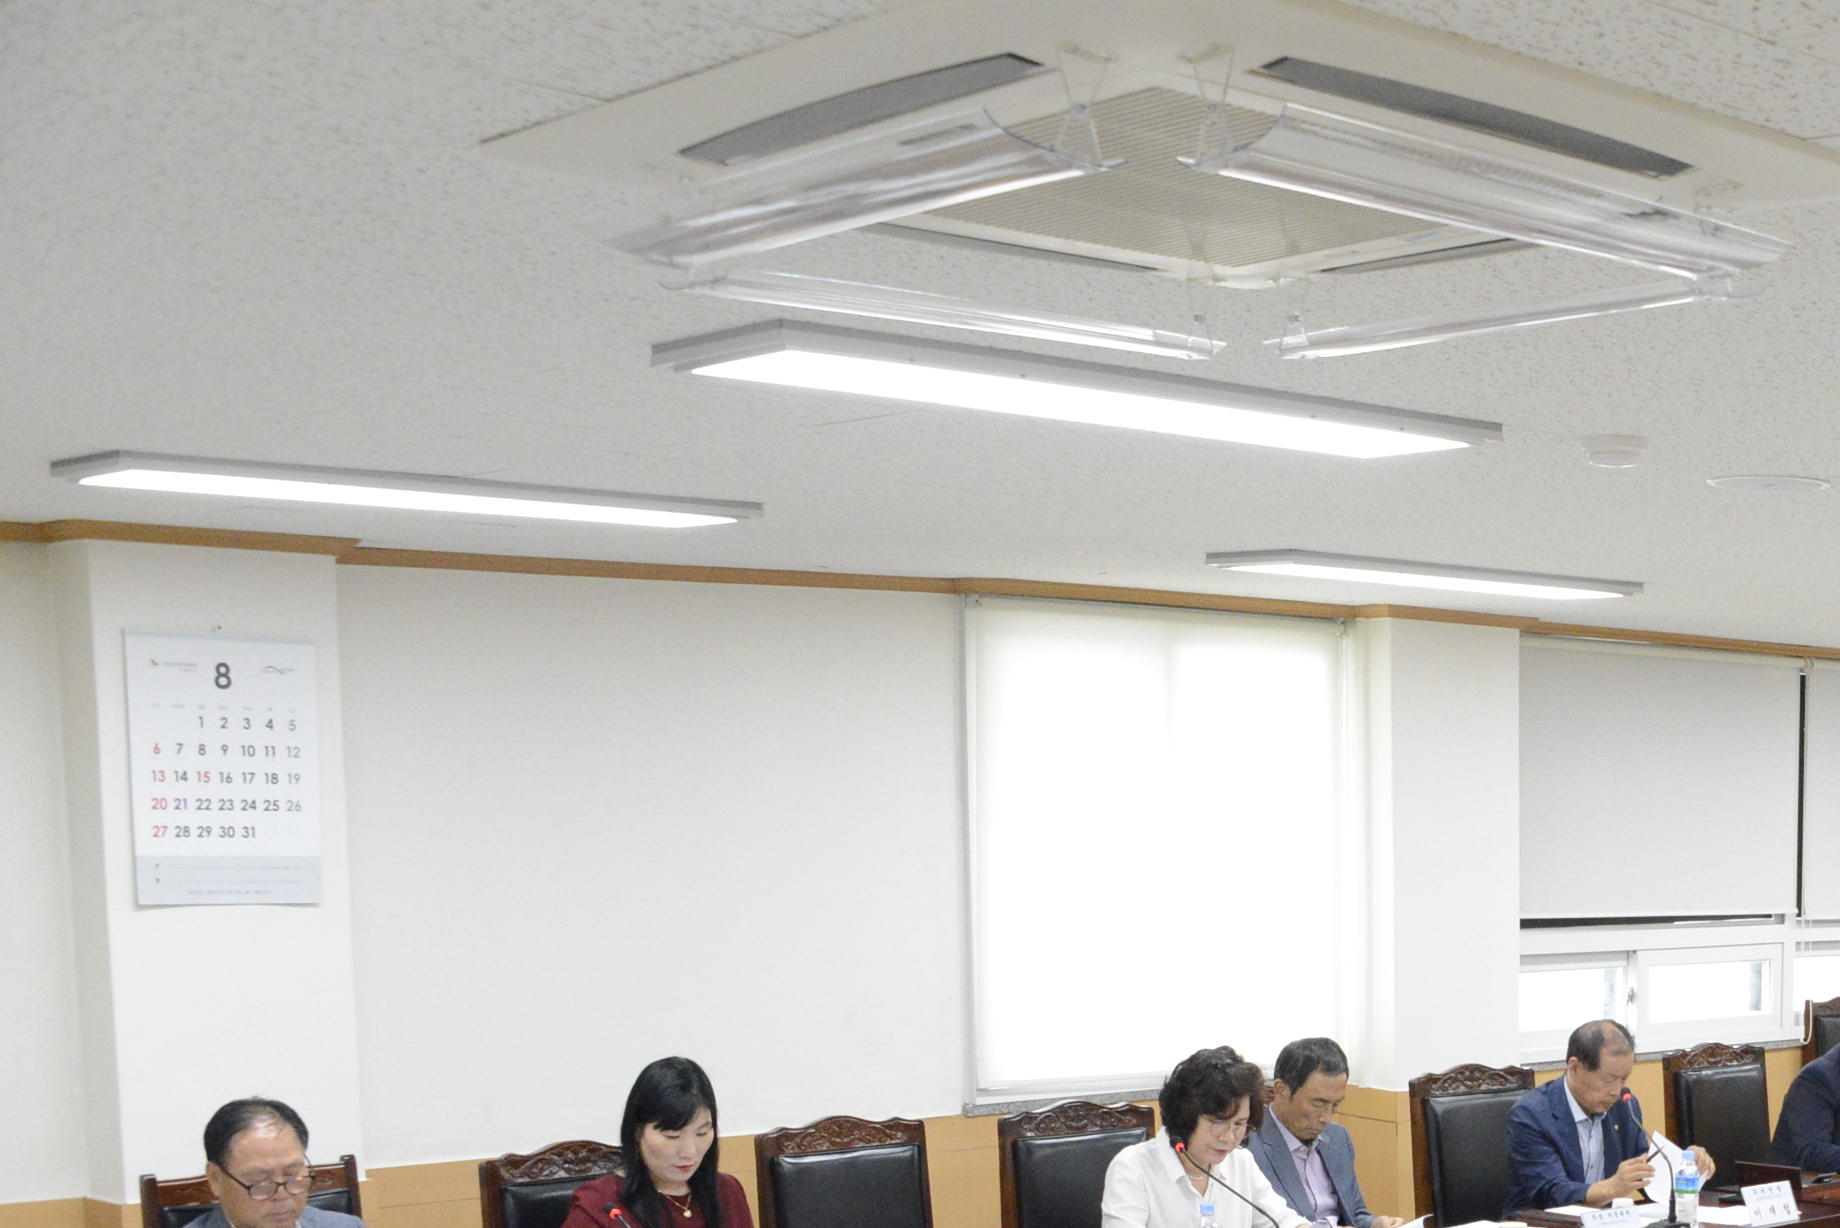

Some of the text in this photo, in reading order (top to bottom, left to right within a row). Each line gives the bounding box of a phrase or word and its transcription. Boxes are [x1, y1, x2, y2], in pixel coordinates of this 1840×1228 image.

[214, 662, 232, 690] 8
[197, 715, 297, 732] 1 2 3 4 5
[152, 742, 301, 759] 6 7 8 9 10 11 12
[151, 769, 302, 786] 13 14 15 16 17 18 19
[150, 797, 303, 813] 20 21 22 23 24 25 26
[151, 824, 256, 839] 27 28 29 30 31
